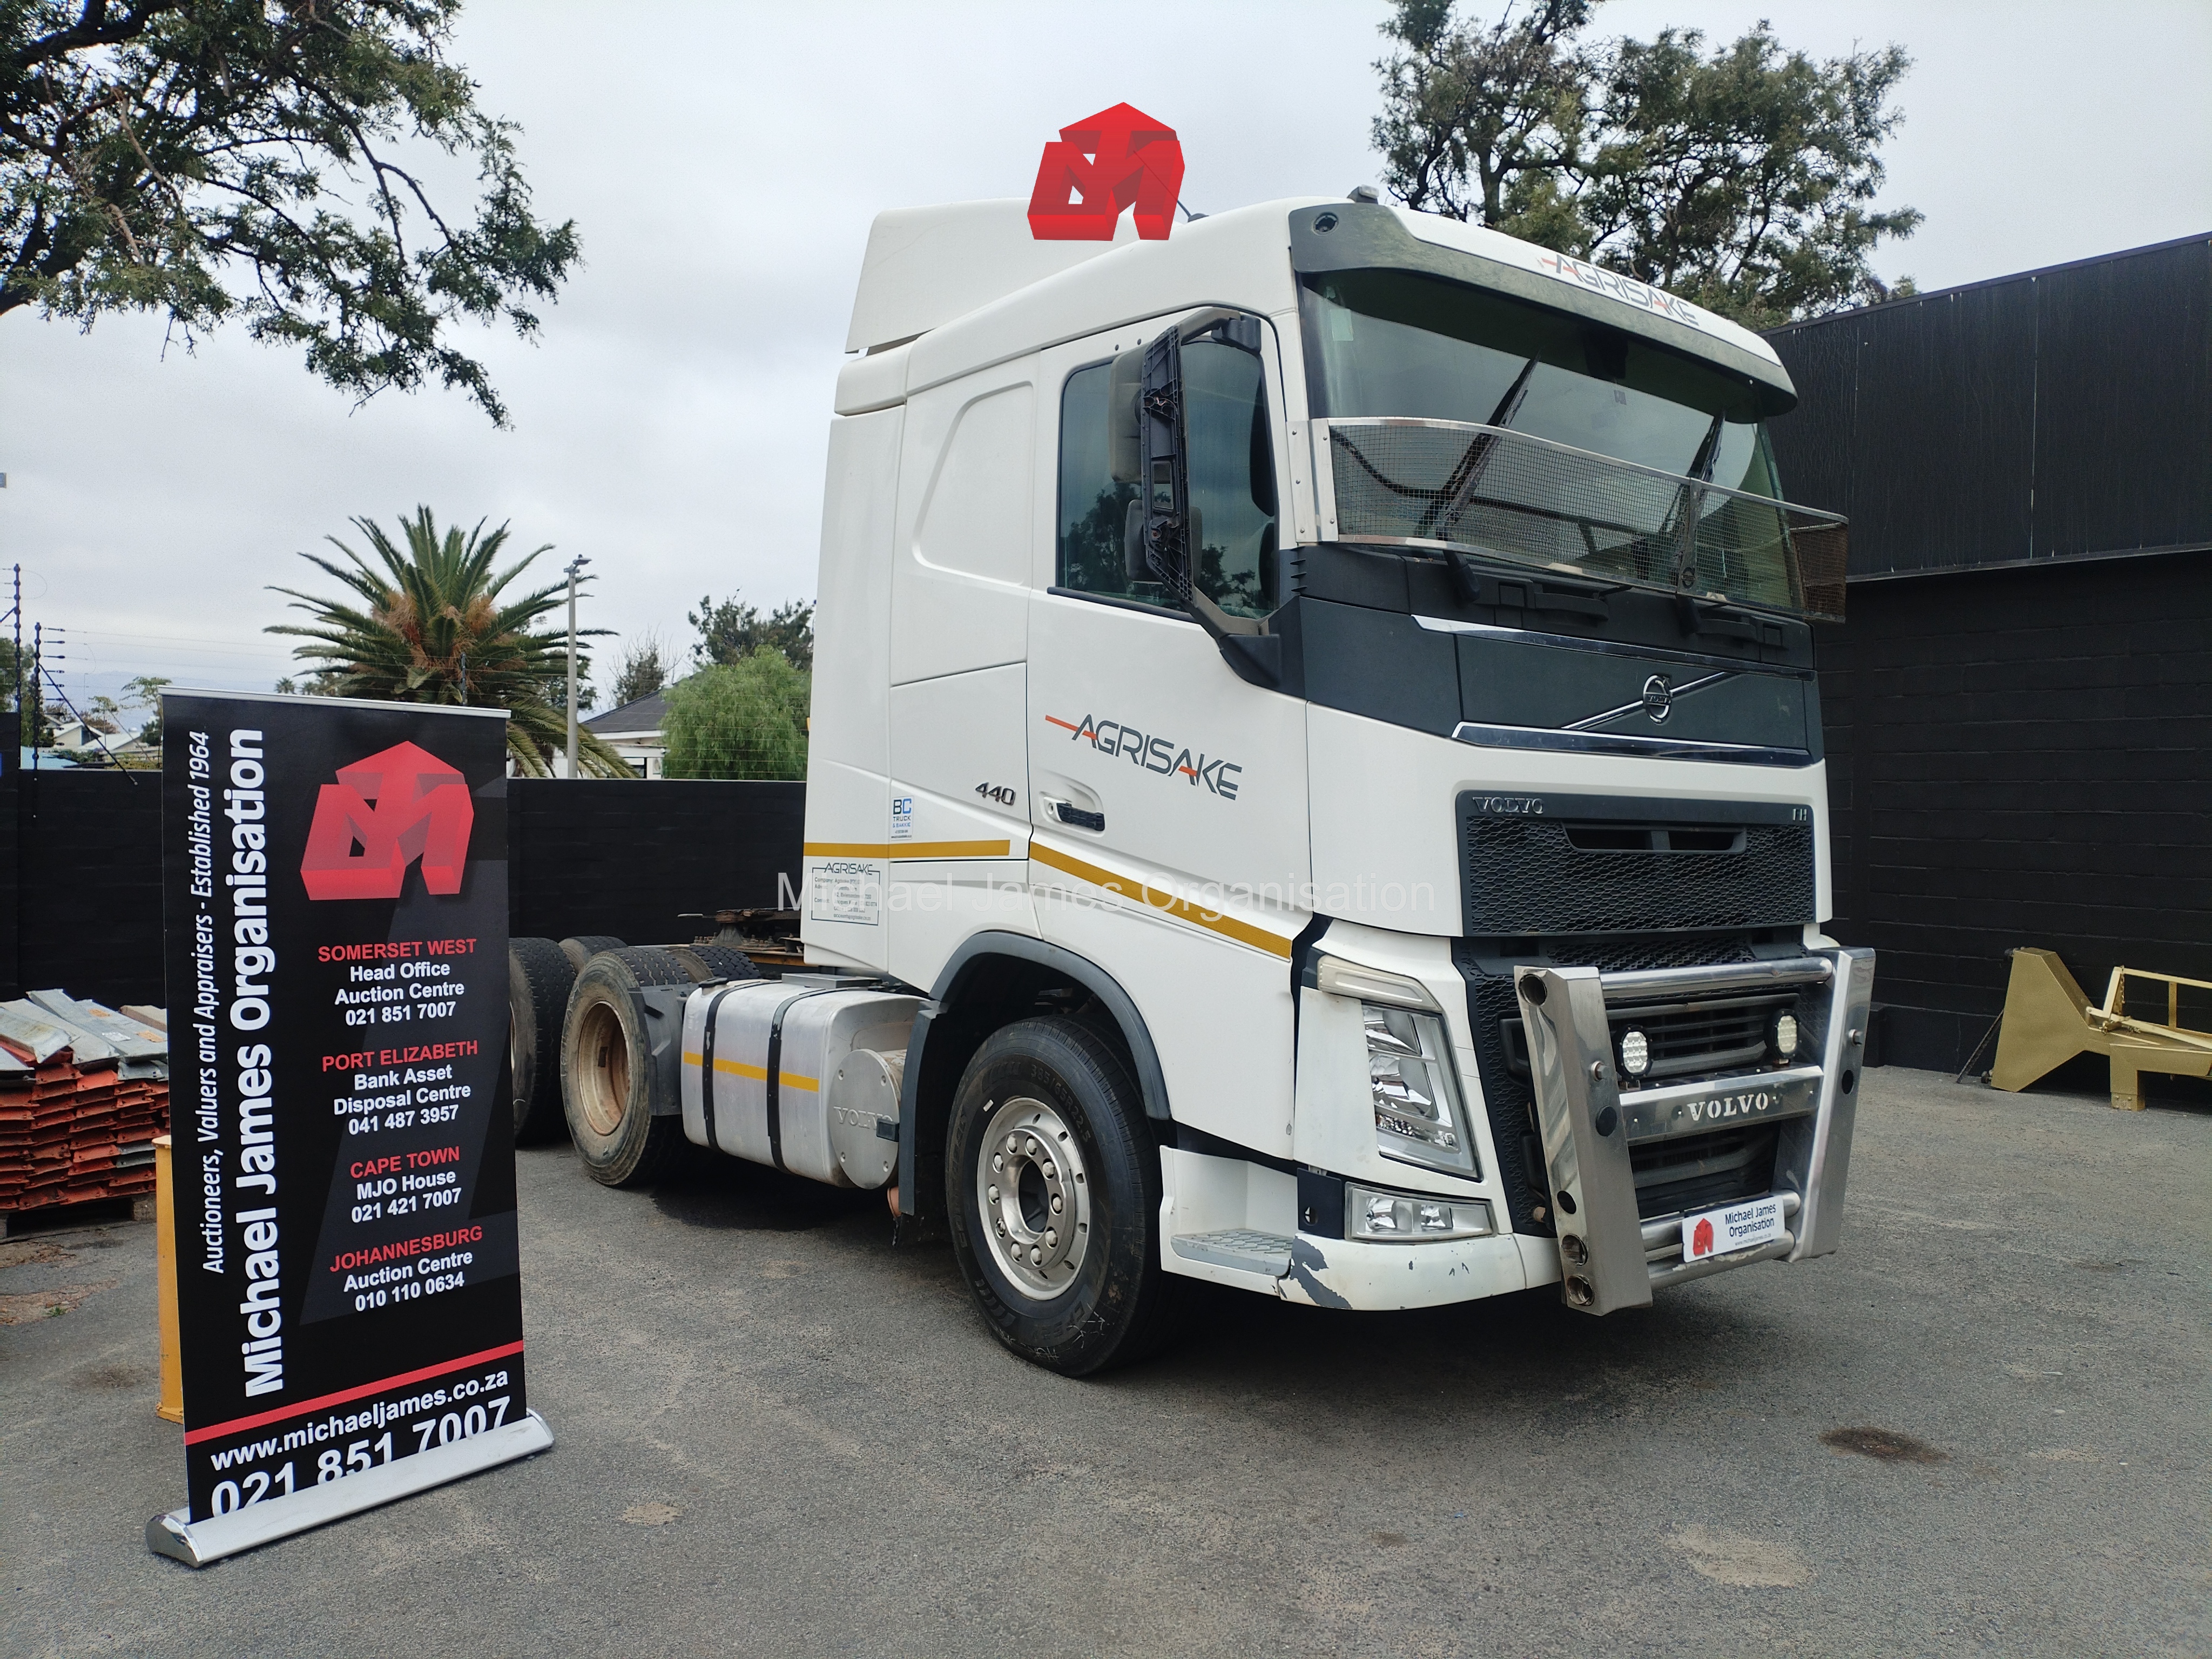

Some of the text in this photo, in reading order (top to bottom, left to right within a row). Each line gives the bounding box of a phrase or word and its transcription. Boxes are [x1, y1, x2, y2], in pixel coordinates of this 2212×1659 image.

[1541, 254, 1699, 326] AGRISAKE
[189, 731, 210, 779] 1964
[1046, 714, 1243, 800] AGRISAKE
[893, 798, 912, 815] BC
[975, 781, 1016, 806] 440
[1472, 797, 1545, 814] VOLVO
[187, 784, 212, 898] Established
[824, 862, 873, 875] AGRISAKE
[318, 938, 476, 962] SOMERSET WEST
[191, 914, 220, 1020] Appraisers
[350, 961, 450, 982] Head Office
[334, 981, 465, 1005] Auction Centre
[345, 1001, 456, 1026] 021 851 7007
[192, 1023, 216, 1062] and
[322, 1041, 478, 1072] PORT ELIZABETH
[223, 729, 283, 1397] Michael James Organisation
[354, 1064, 453, 1090] Bank Asset
[195, 1068, 218, 1142] Valuers
[334, 1084, 471, 1115] Disposal Centre
[1687, 1092, 1769, 1121] VOLVO
[348, 1104, 459, 1135] 041 487 3957
[350, 1146, 460, 1178] CAPE TOWN
[356, 1171, 456, 1201] MJO House
[199, 1149, 224, 1274] Auctioneers,
[351, 1187, 462, 1223] 021 421 7007
[1725, 1204, 1776, 1225] Michael James
[1729, 1218, 1775, 1237] Organisation
[330, 1225, 482, 1272] JOHANNESBURG
[343, 1252, 473, 1292] Auction Centre
[355, 1271, 465, 1311] 010 110 0634
[210, 1370, 508, 1471] www.michaeljames.co.za
[211, 1395, 510, 1518] 021 851 7007
